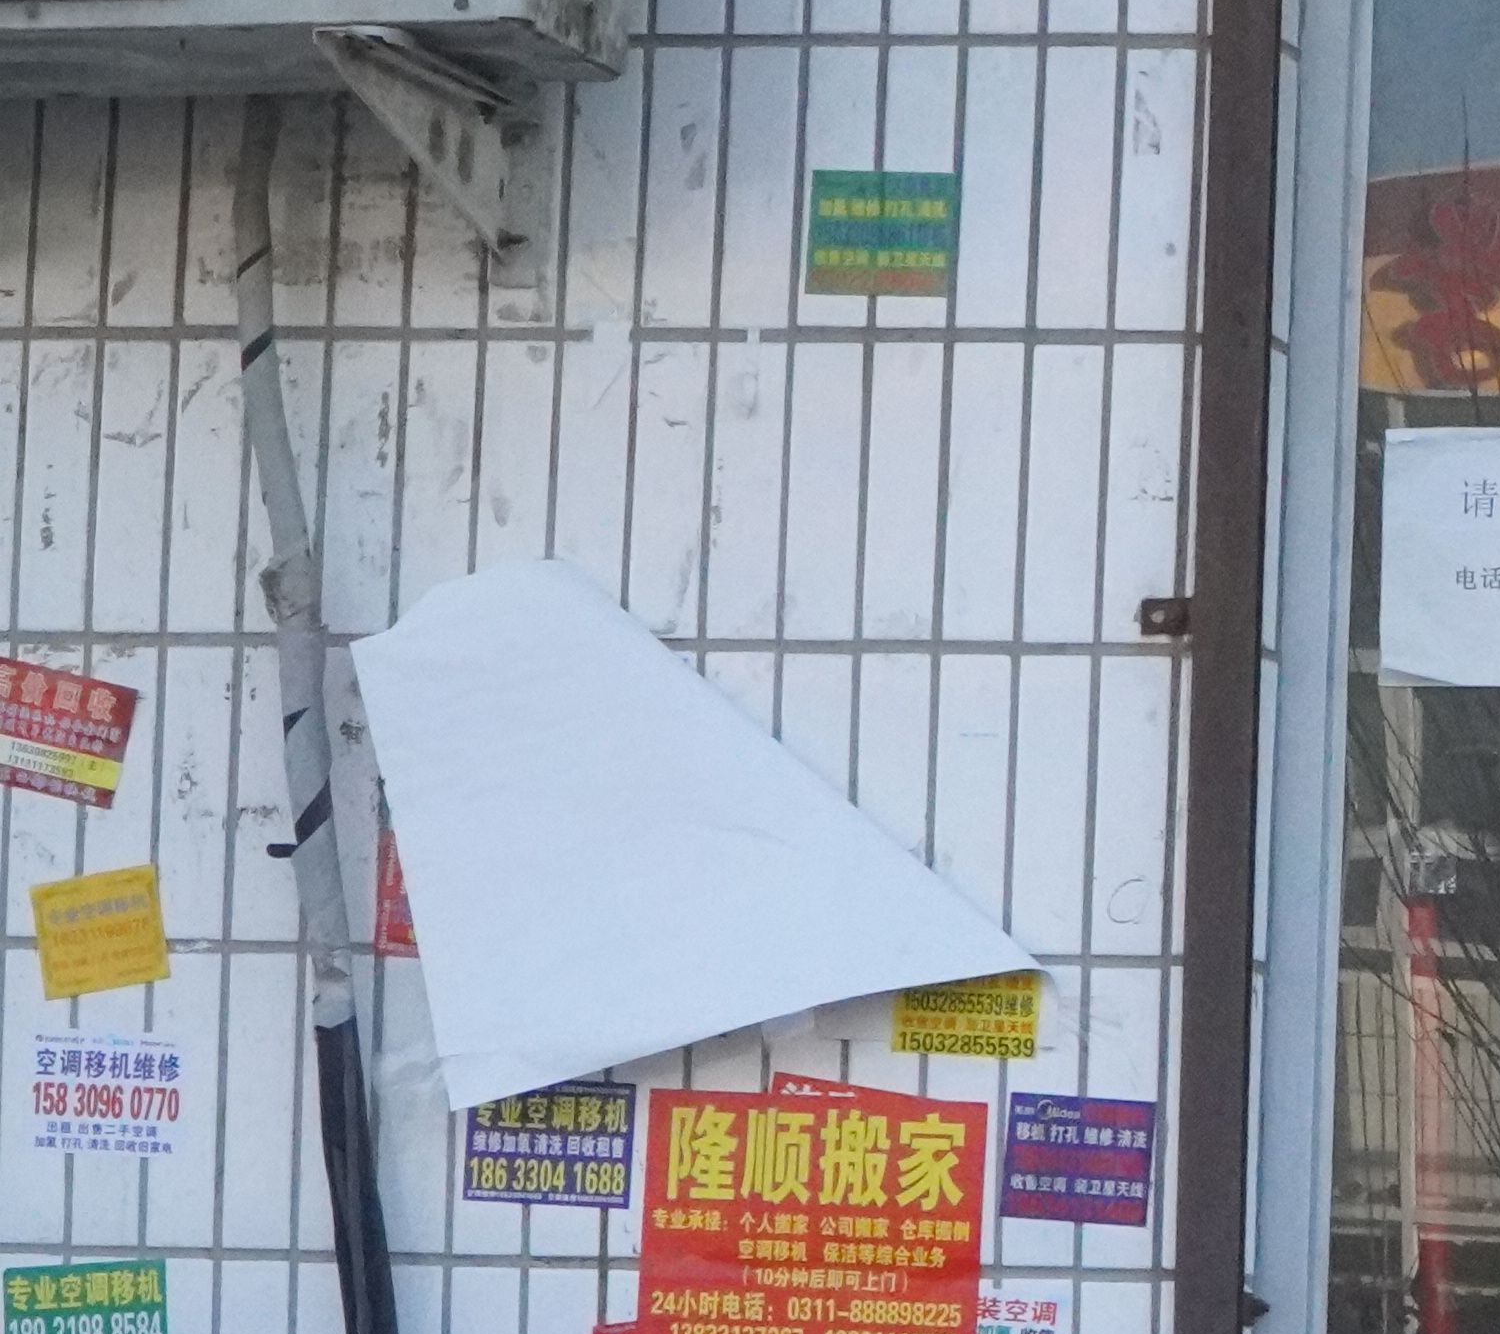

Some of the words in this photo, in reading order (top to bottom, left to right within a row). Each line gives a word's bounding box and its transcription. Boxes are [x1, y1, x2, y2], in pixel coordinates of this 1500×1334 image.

[898, 1031, 1036, 1058] 15032855539
[36, 1048, 181, 1082] 空调移机维修
[32, 1081, 68, 1117] 158
[73, 1083, 125, 1119] 3096
[130, 1086, 181, 1123] 0770
[475, 1094, 630, 1133] 专业空调移机
[61, 1137, 83, 1150] 打孔
[78, 1122, 158, 1139] 出售二手空调
[1050, 1124, 1080, 1145] 打孔
[665, 1102, 968, 1212] 隆顺搬家
[469, 1156, 508, 1191] 186
[511, 1157, 566, 1193] 3304
[573, 1160, 626, 1196] 1688
[739, 1211, 809, 1236] 个人搬家
[819, 1215, 892, 1240] 公司搬家
[738, 1238, 808, 1265] 空调移机
[822, 1241, 947, 1269] 保洁等综合业务
[7, 1269, 163, 1312] 专业空调移机
